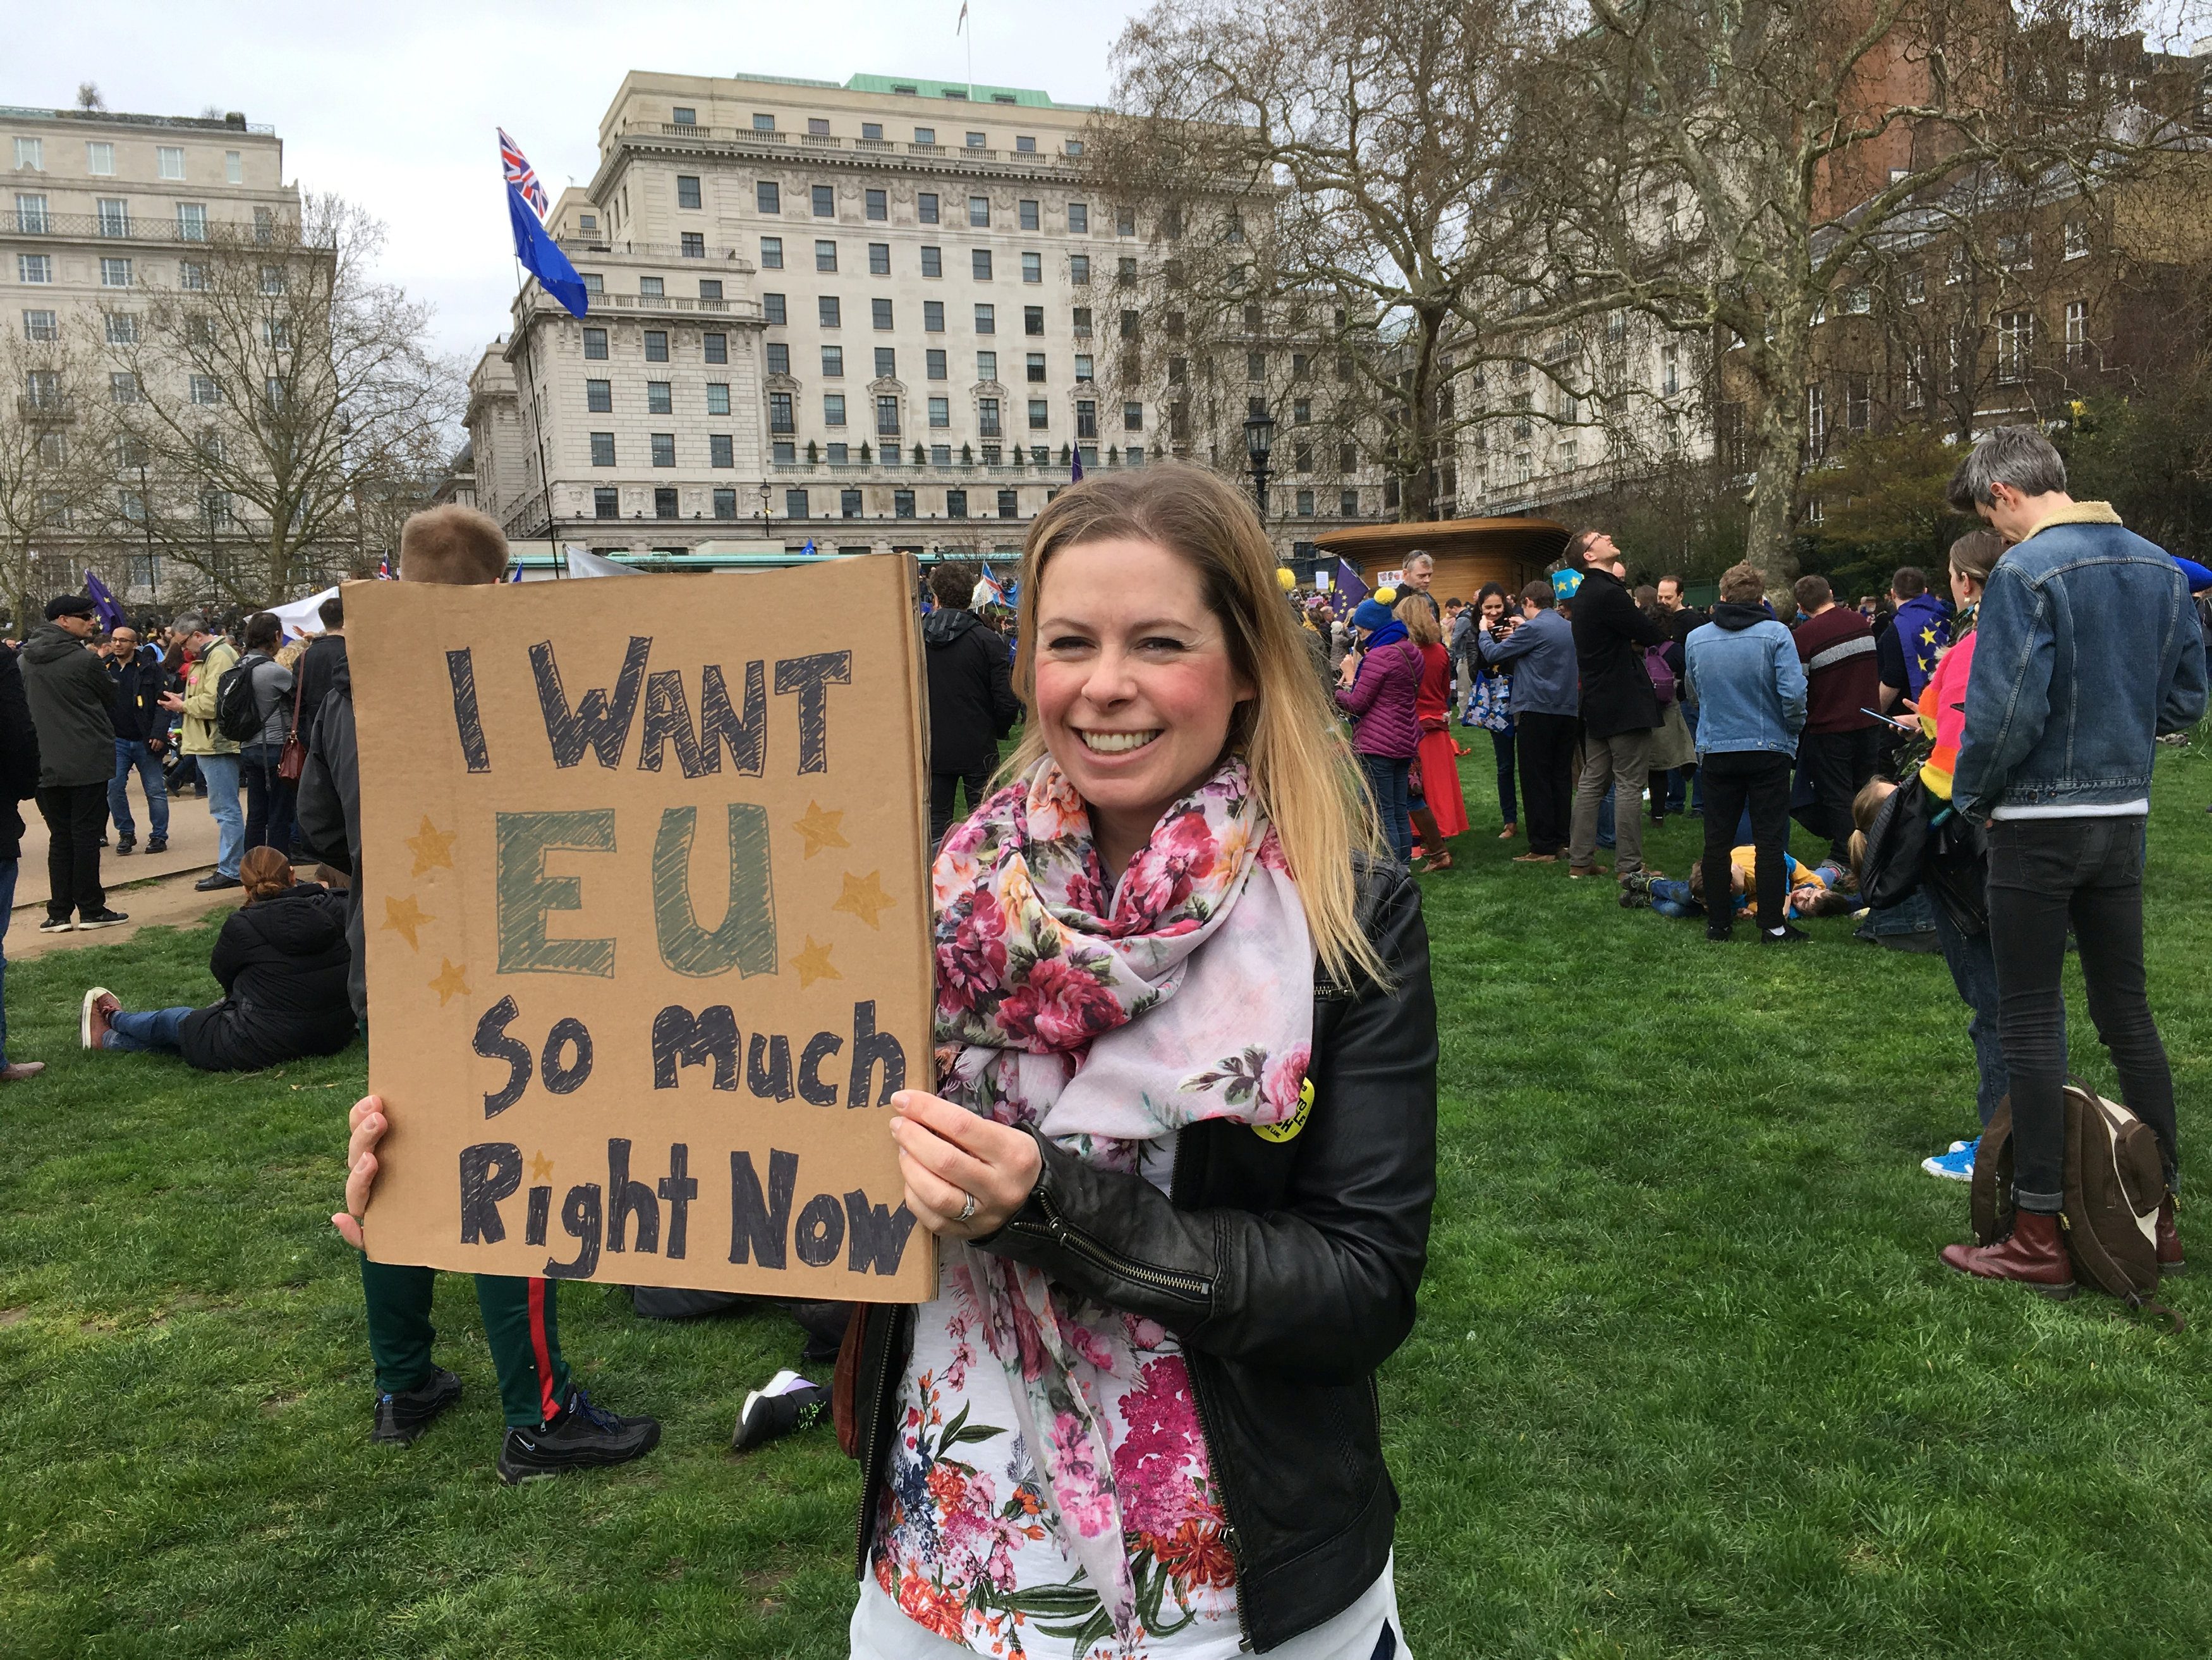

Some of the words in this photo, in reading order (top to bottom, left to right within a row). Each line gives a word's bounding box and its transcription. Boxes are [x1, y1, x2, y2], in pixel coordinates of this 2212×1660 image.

[446, 646, 490, 774] I
[528, 636, 852, 779] WANT
[495, 803, 779, 979] EU
[652, 1000, 906, 1109] Much
[460, 1138, 698, 1278] Right
[729, 1149, 918, 1276] Now
